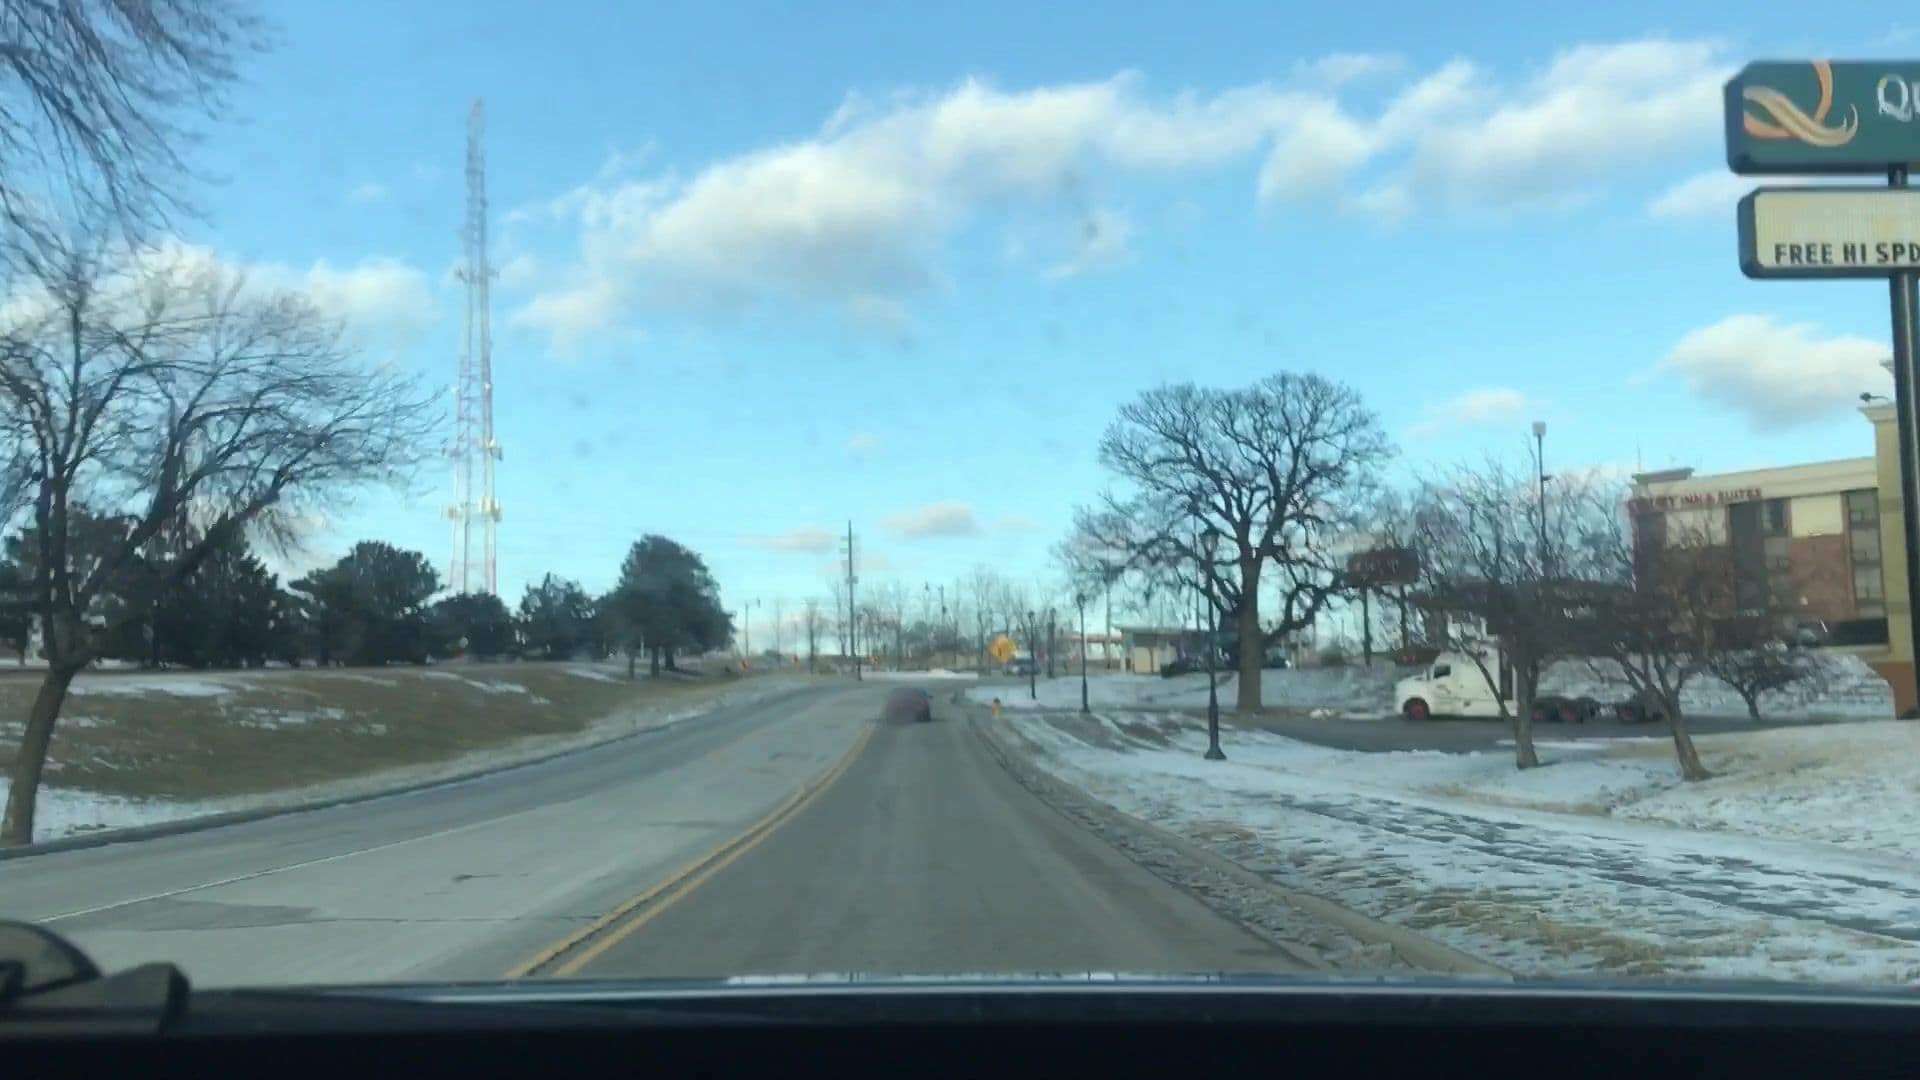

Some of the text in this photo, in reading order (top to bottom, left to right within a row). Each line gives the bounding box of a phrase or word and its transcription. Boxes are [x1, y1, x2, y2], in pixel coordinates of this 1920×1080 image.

[1774, 242, 1920, 264] FREE HI SPD
